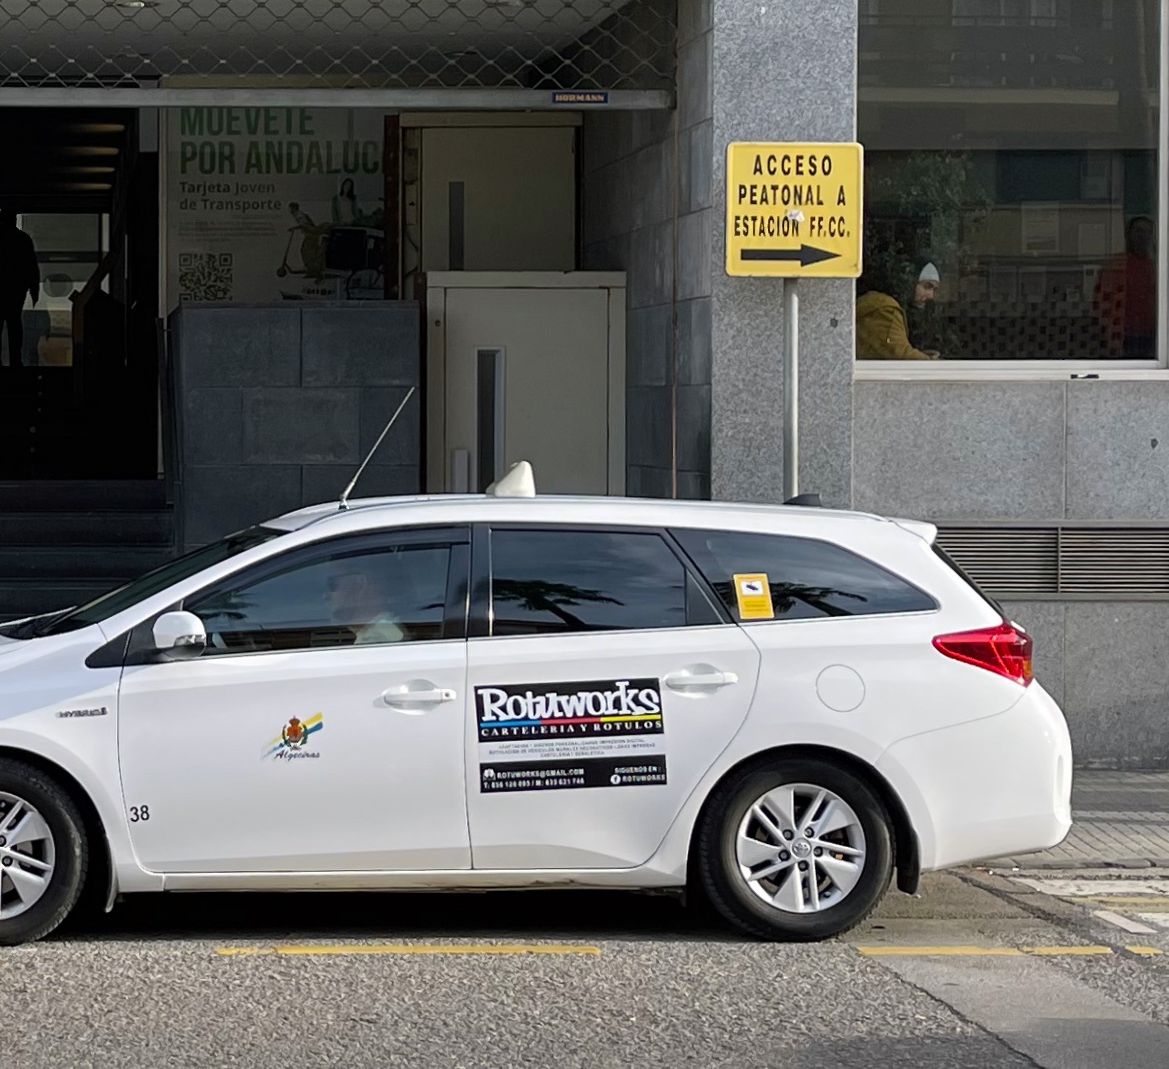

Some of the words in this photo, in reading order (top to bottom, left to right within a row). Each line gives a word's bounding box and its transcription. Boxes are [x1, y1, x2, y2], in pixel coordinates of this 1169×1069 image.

[180, 140, 236, 175] POR
[753, 154, 833, 176] ACCESO
[179, 181, 231, 196] Tarjeta
[234, 181, 276, 195] Joven
[738, 184, 825, 206] PEATONAL
[837, 185, 847, 206] A
[180, 198, 197, 211] de
[201, 198, 283, 214] Transporte
[809, 216, 851, 238] FF.CC.
[481, 723, 575, 737] CARTELERIA
[580, 723, 588, 732] Y
[593, 720, 663, 732] ROTULOS
[274, 749, 321, 762] Algeciras
[130, 805, 150, 823] 38
